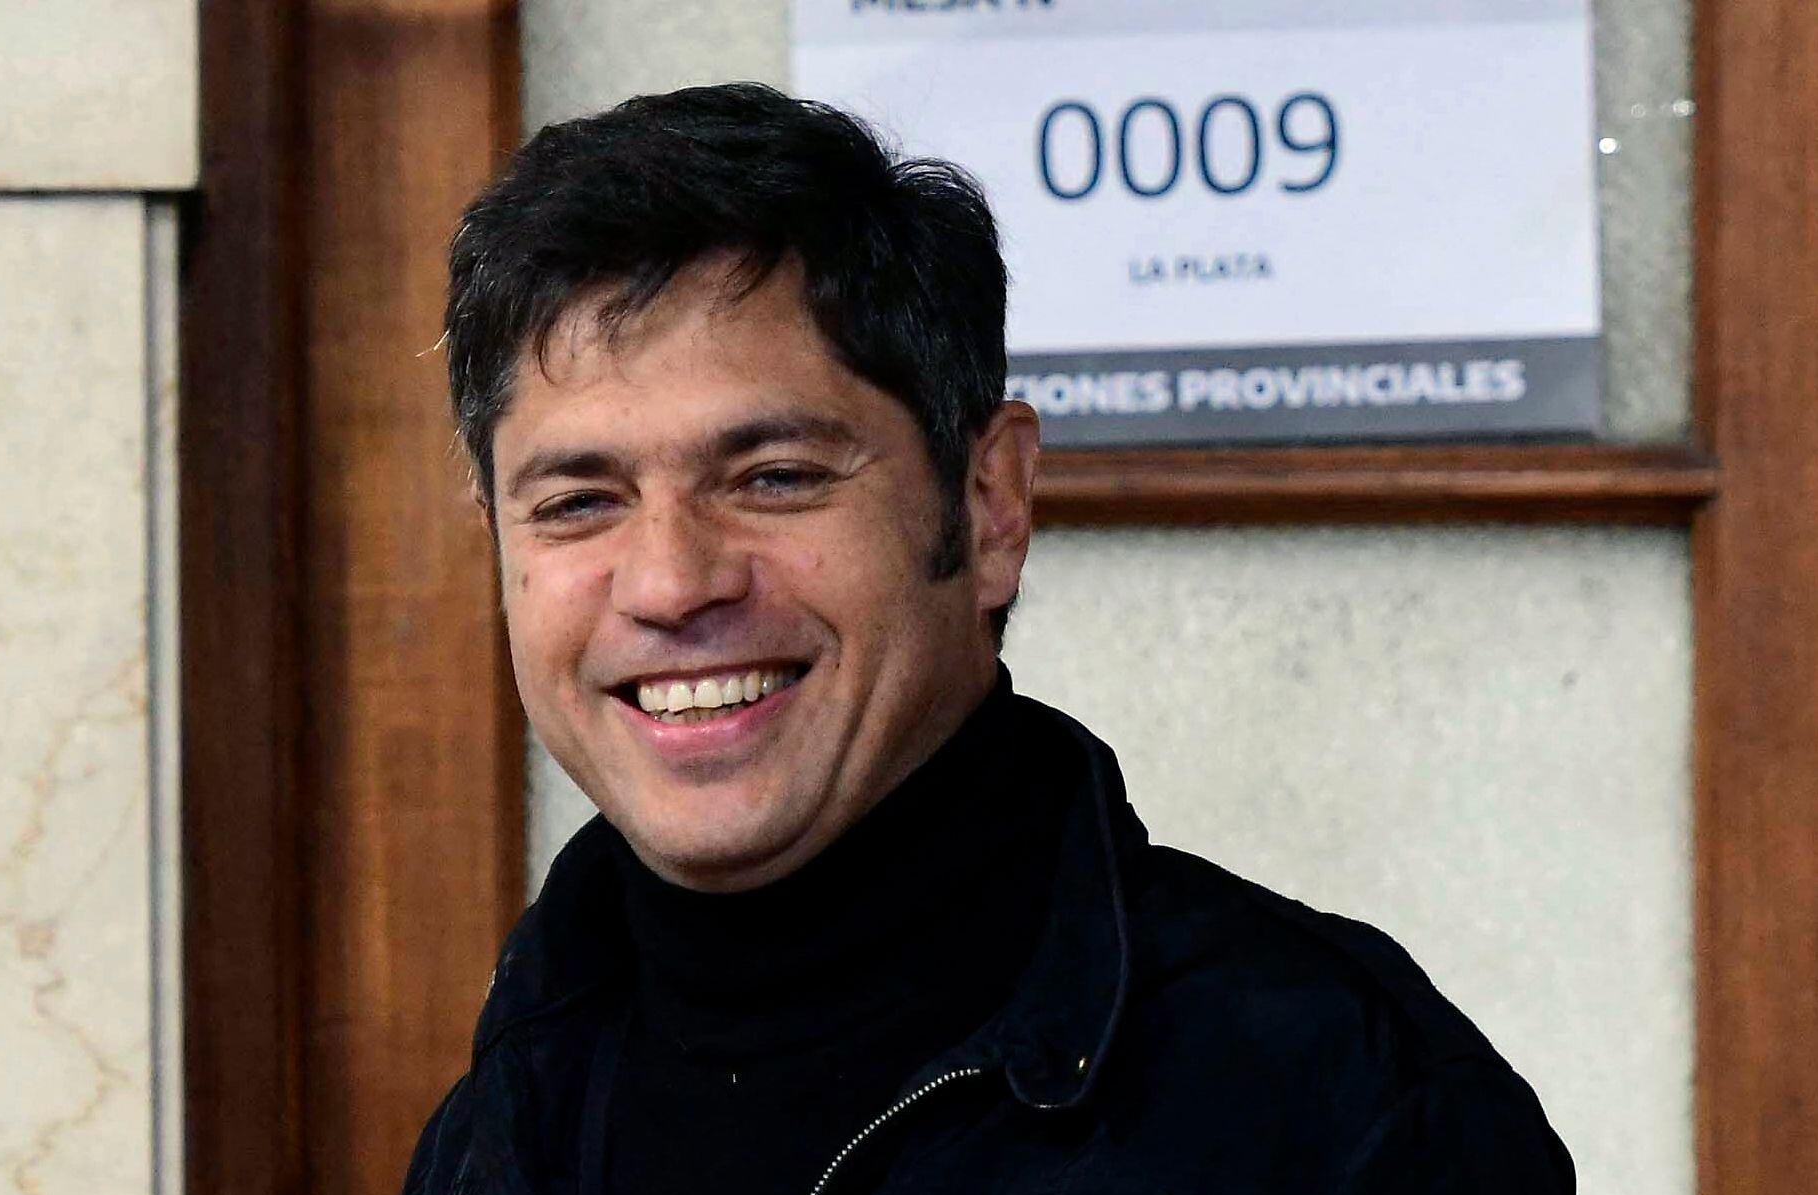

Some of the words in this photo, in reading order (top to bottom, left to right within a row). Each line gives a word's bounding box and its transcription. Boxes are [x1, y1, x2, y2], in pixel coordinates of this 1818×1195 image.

[1039, 91, 1337, 200] 0009
[1128, 256, 1164, 283] LA
[1176, 253, 1272, 282] PLATA
[1177, 359, 1526, 411] PROVINCIALES
